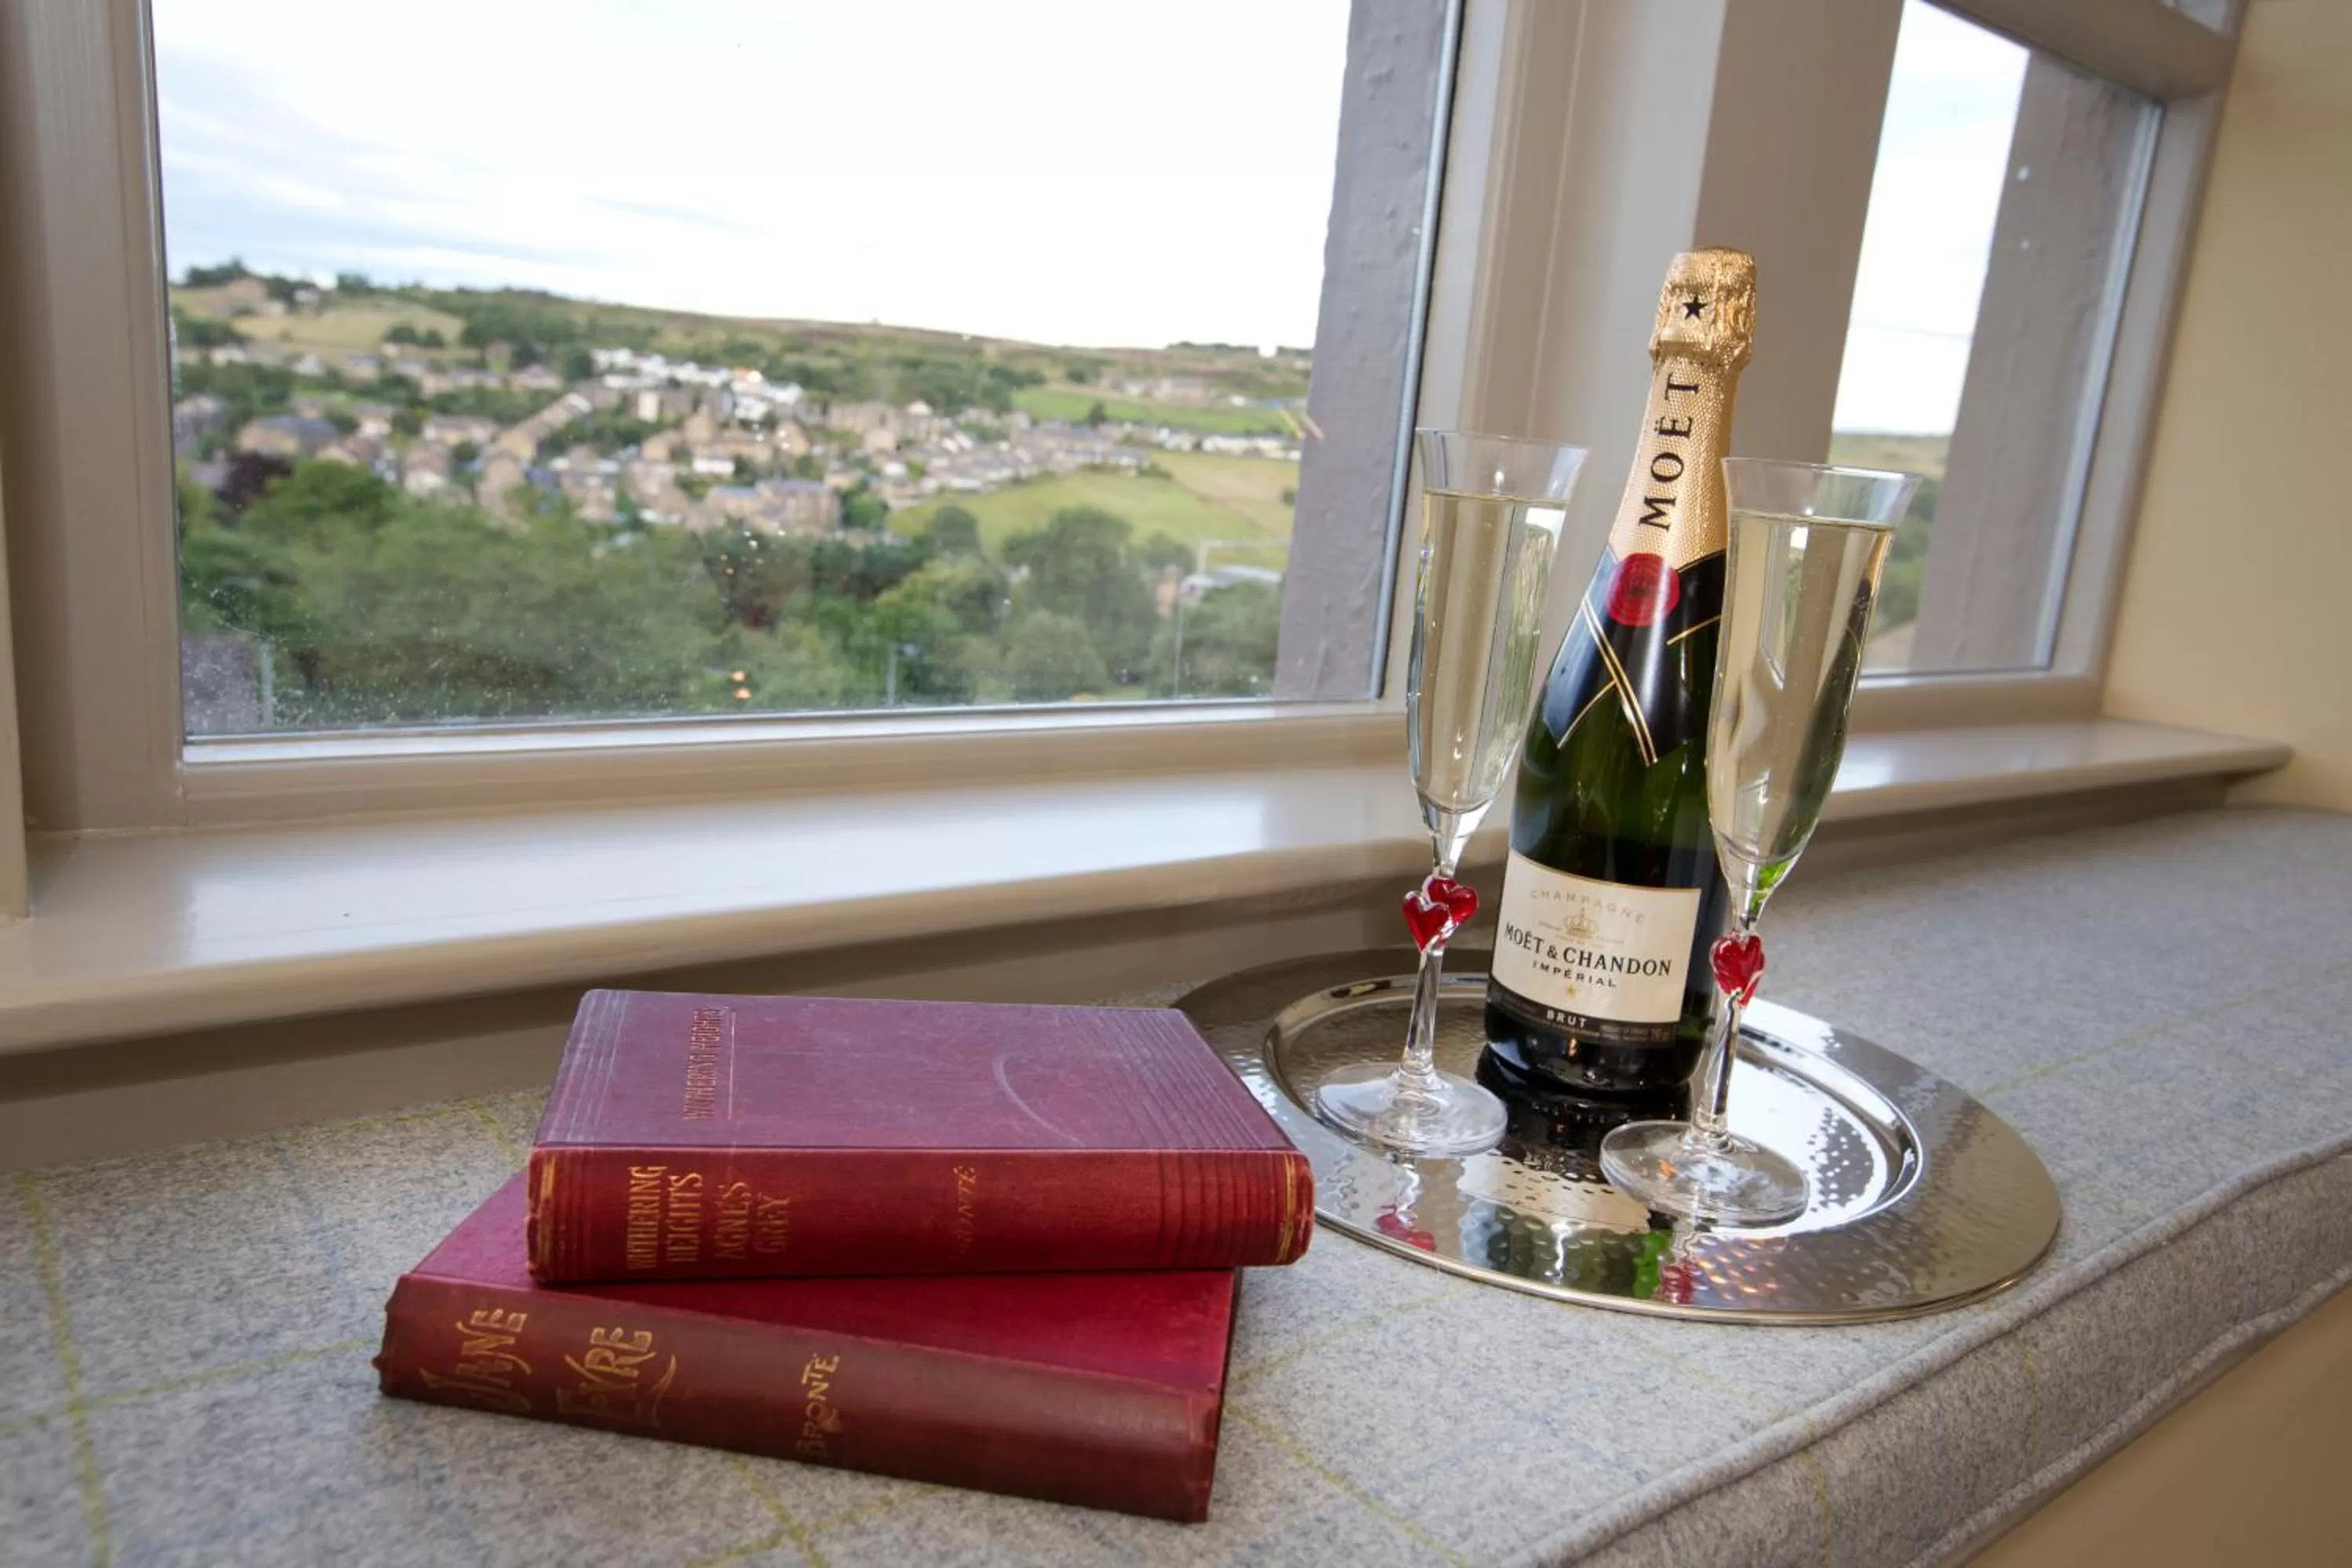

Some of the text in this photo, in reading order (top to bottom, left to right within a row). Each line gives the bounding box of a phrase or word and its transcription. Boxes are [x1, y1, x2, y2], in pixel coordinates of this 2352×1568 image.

[1639, 372, 1700, 531] MOËT
[1504, 922, 1544, 955] MOËT
[1547, 944, 1559, 959] &
[1563, 946, 1672, 976] CHANDON
[1530, 890, 1646, 924] CHAMPAGNE
[1546, 1009, 1588, 1029] BRUT
[628, 1165, 667, 1269] WUTHERING
[667, 1172, 702, 1263] HEIGHTS
[714, 1181, 753, 1260] AGNES
[419, 1308, 532, 1410] JANE
[555, 1326, 677, 1427] EYRE
